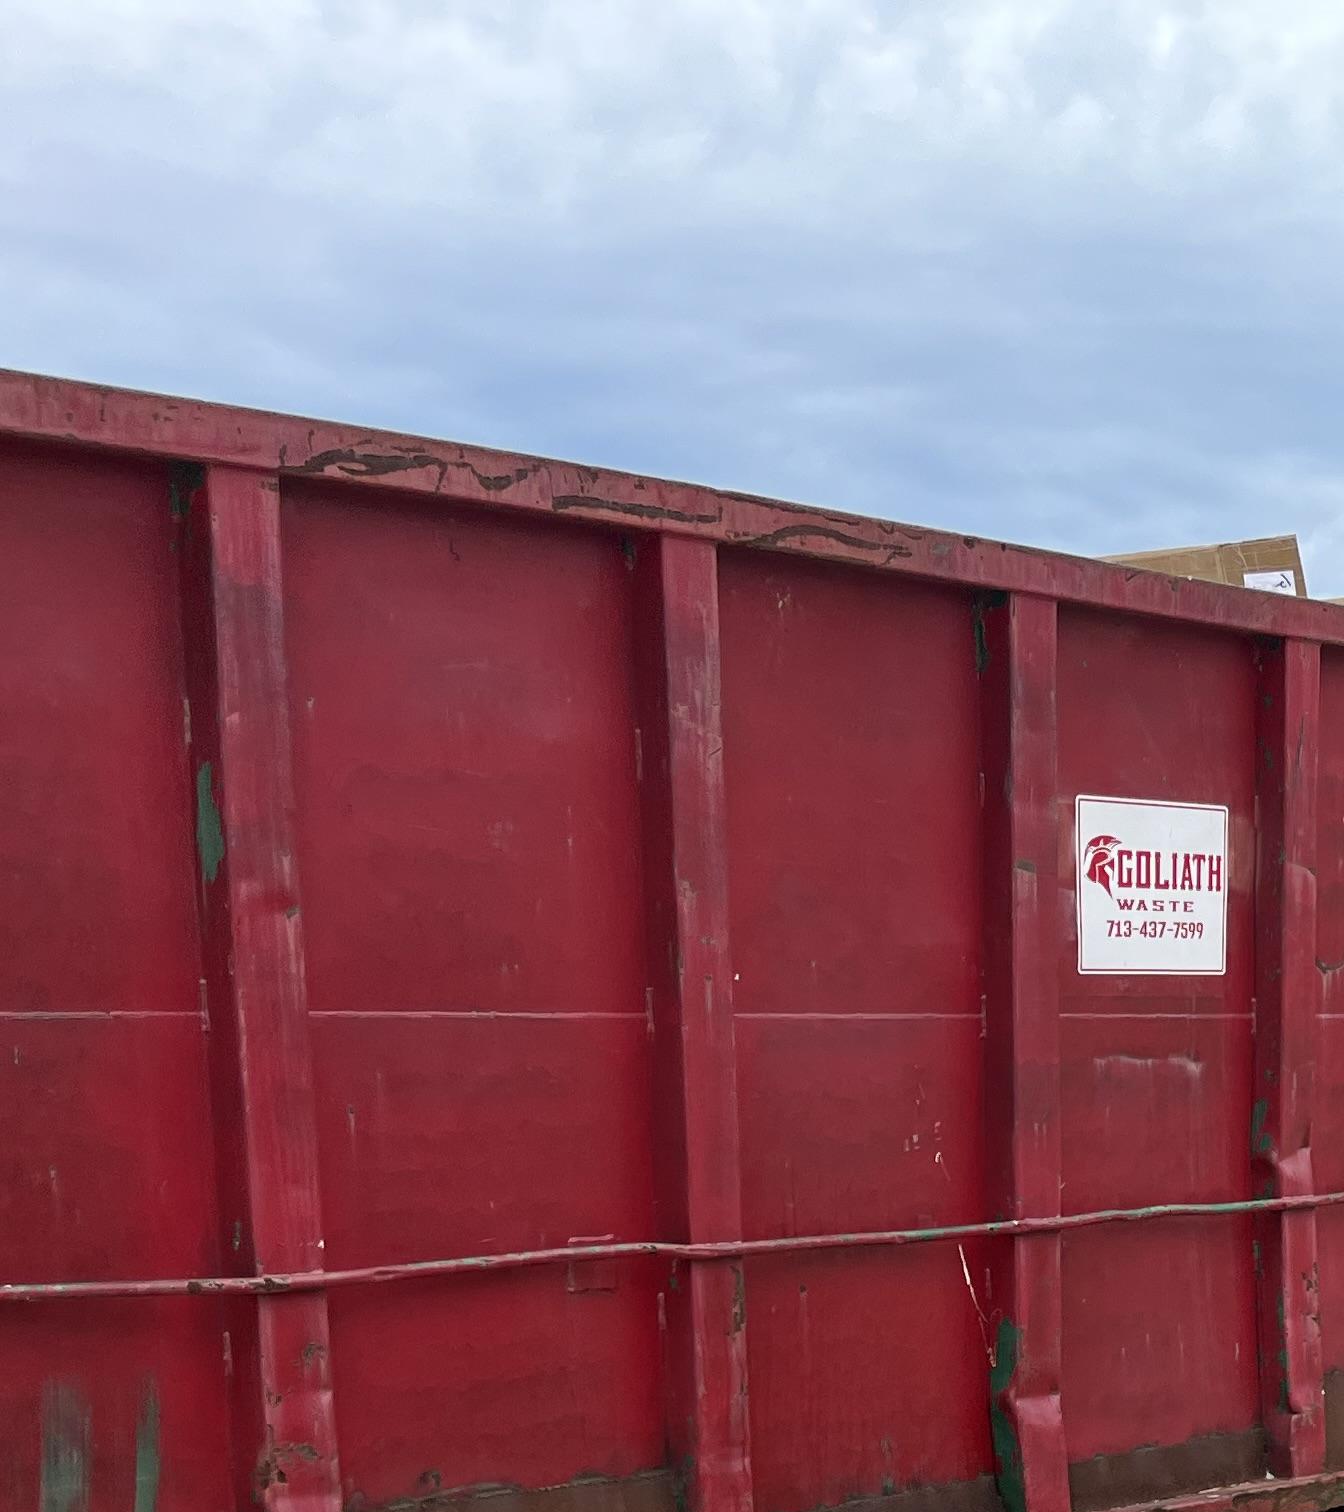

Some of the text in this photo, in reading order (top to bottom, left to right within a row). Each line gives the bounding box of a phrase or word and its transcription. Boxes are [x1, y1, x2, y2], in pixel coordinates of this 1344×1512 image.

[1116, 850, 1222, 892] GOLIATH
[1116, 898, 1195, 913] WASTE
[1106, 920, 1204, 939] 713-437-7599
